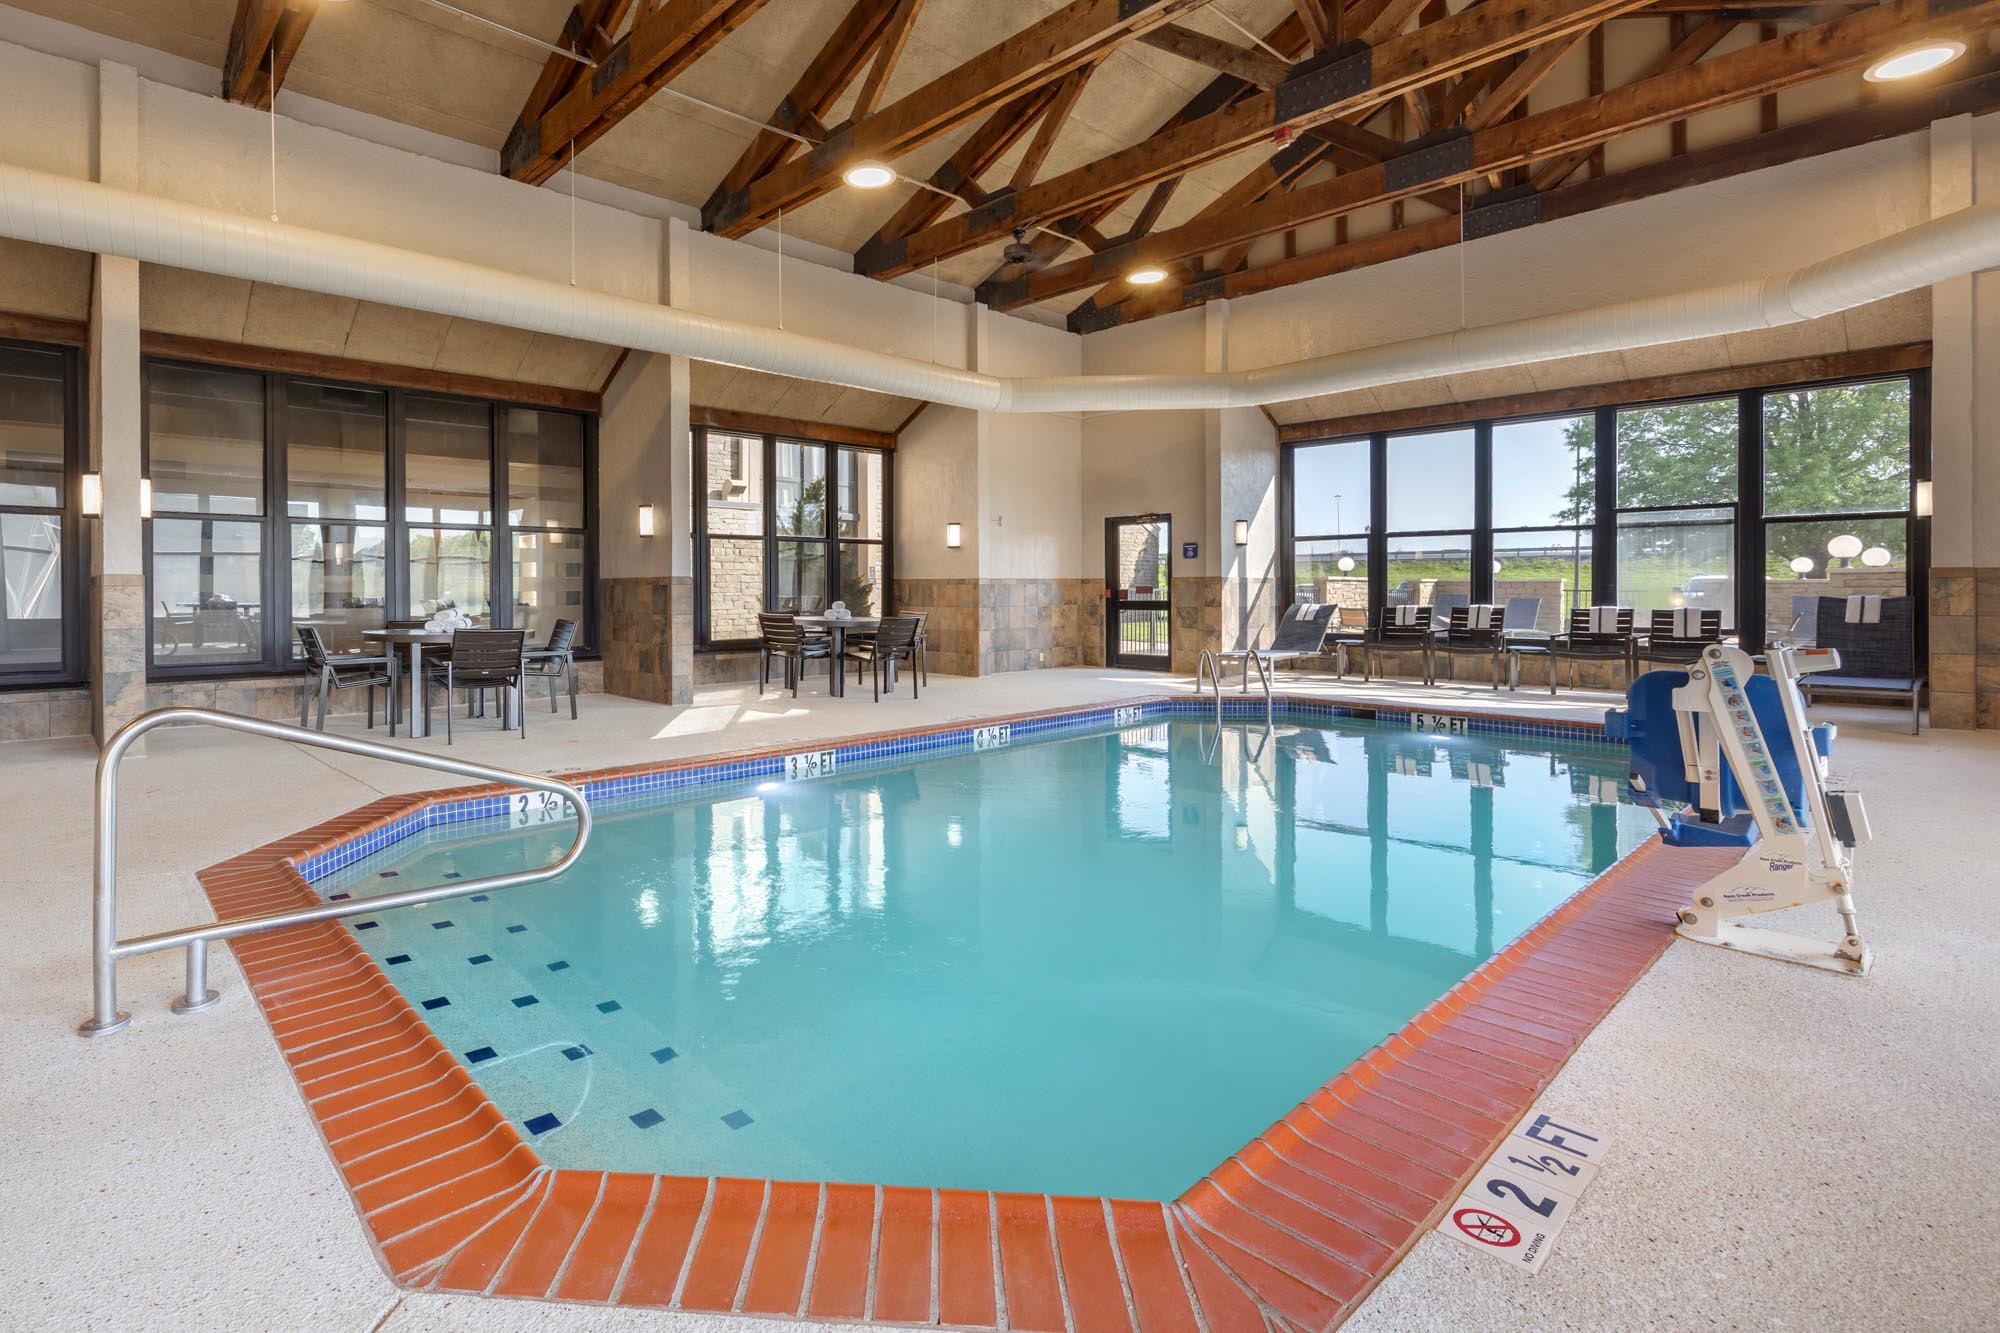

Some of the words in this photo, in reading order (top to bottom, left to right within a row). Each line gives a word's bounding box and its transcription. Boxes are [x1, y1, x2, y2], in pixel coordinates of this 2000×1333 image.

[1770, 861, 1793, 871] Ranger
[1487, 1179, 1558, 1218] 2
[1525, 1114, 1598, 1157] FT
[1522, 1252, 1534, 1264] NO
[1528, 1232, 1545, 1254] DIVING
